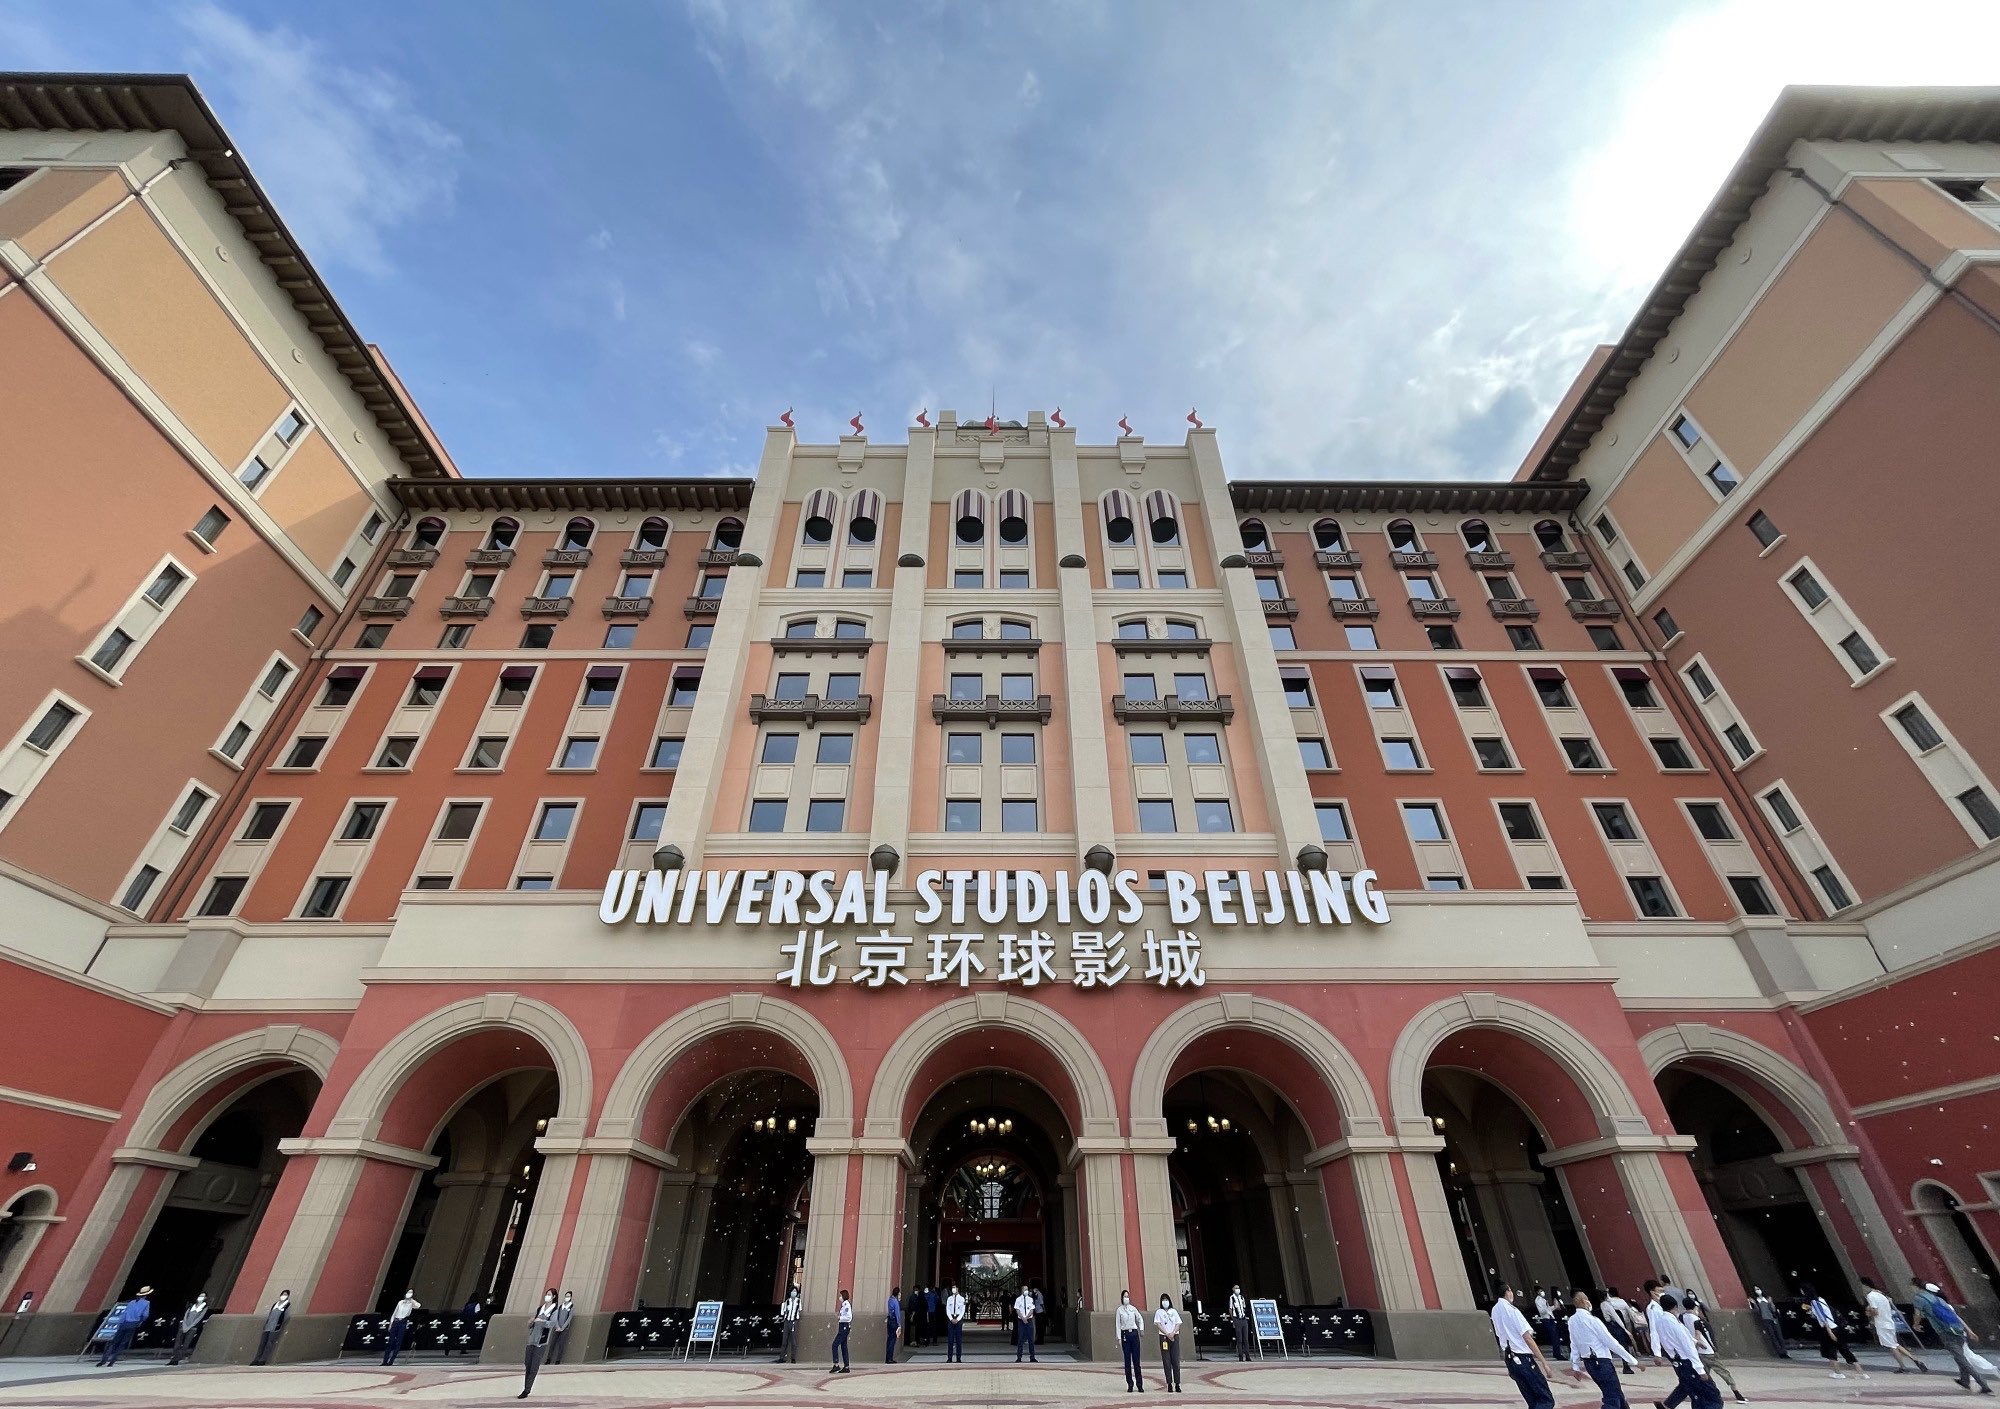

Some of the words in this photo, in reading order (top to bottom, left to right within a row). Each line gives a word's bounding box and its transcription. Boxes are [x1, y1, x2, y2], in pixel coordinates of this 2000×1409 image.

[599, 869, 896, 925] UNIVERSAL
[914, 869, 1144, 925] STUDIOS
[1165, 869, 1391, 925] BEIJING
[776, 929, 1206, 988] 北京环球影城
